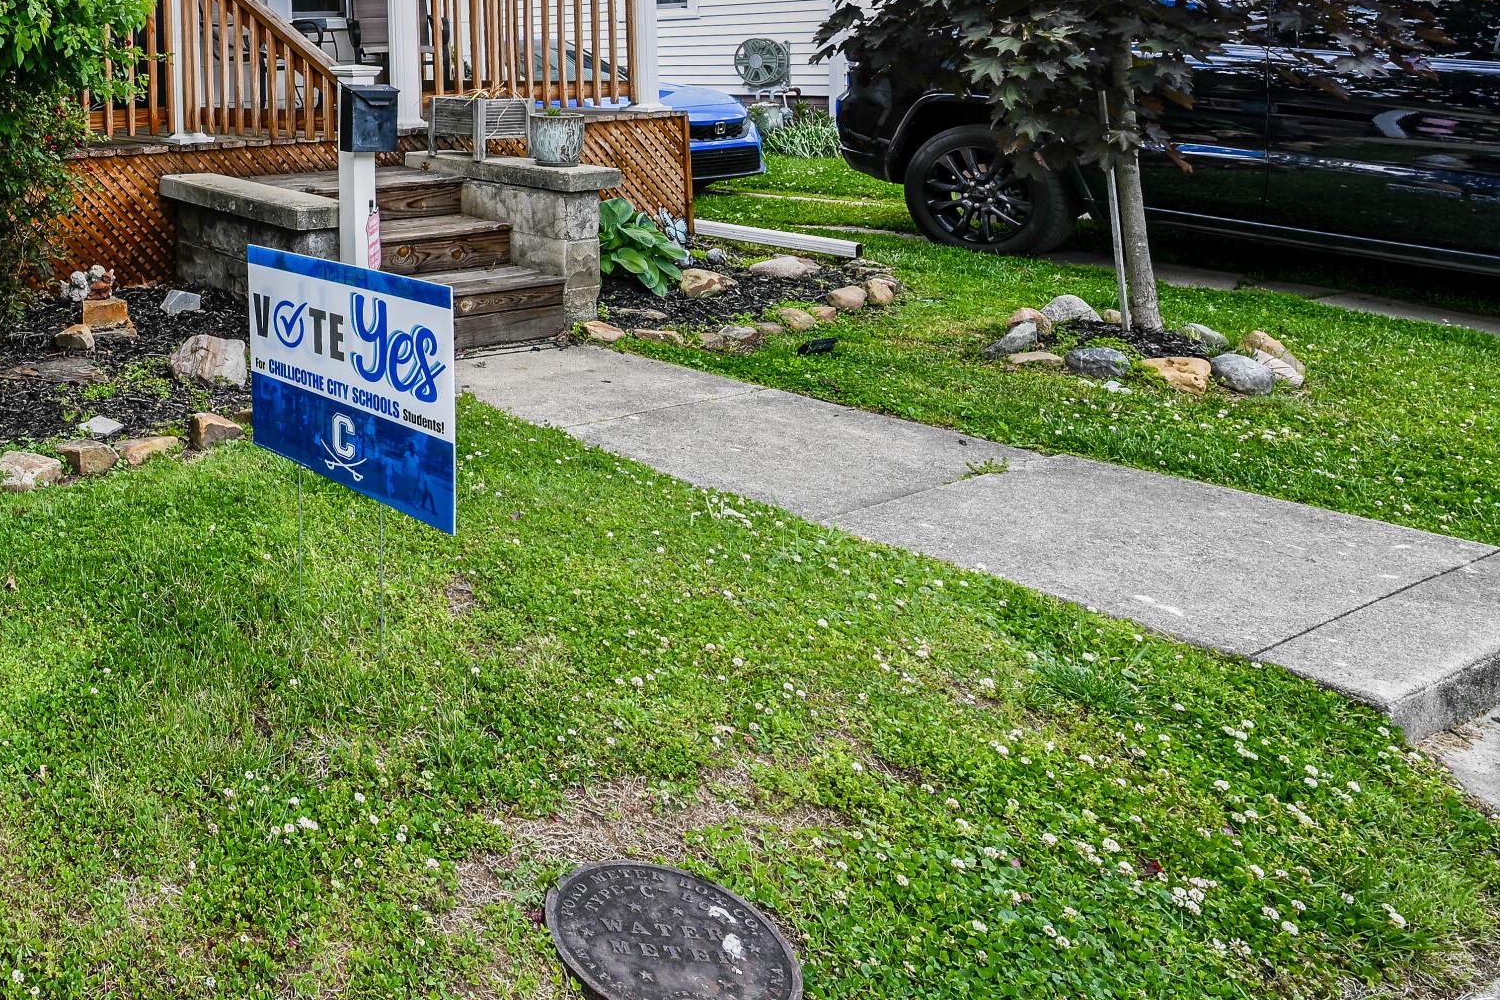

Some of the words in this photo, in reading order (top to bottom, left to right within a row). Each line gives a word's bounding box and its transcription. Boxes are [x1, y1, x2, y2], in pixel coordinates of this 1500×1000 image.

[252, 292, 345, 362] VOTE
[350, 292, 447, 403] Yes
[255, 357, 266, 370] For
[268, 358, 325, 391] CHILLICOTHE
[327, 378, 349, 401] CITY
[352, 387, 400, 419] SCHOOLS
[402, 409, 445, 435] Students!
[331, 411, 356, 461] C
[560, 882, 588, 918] FORD
[590, 868, 667, 885] METER
[600, 917, 725, 942] WATER
[609, 940, 740, 967] METER
